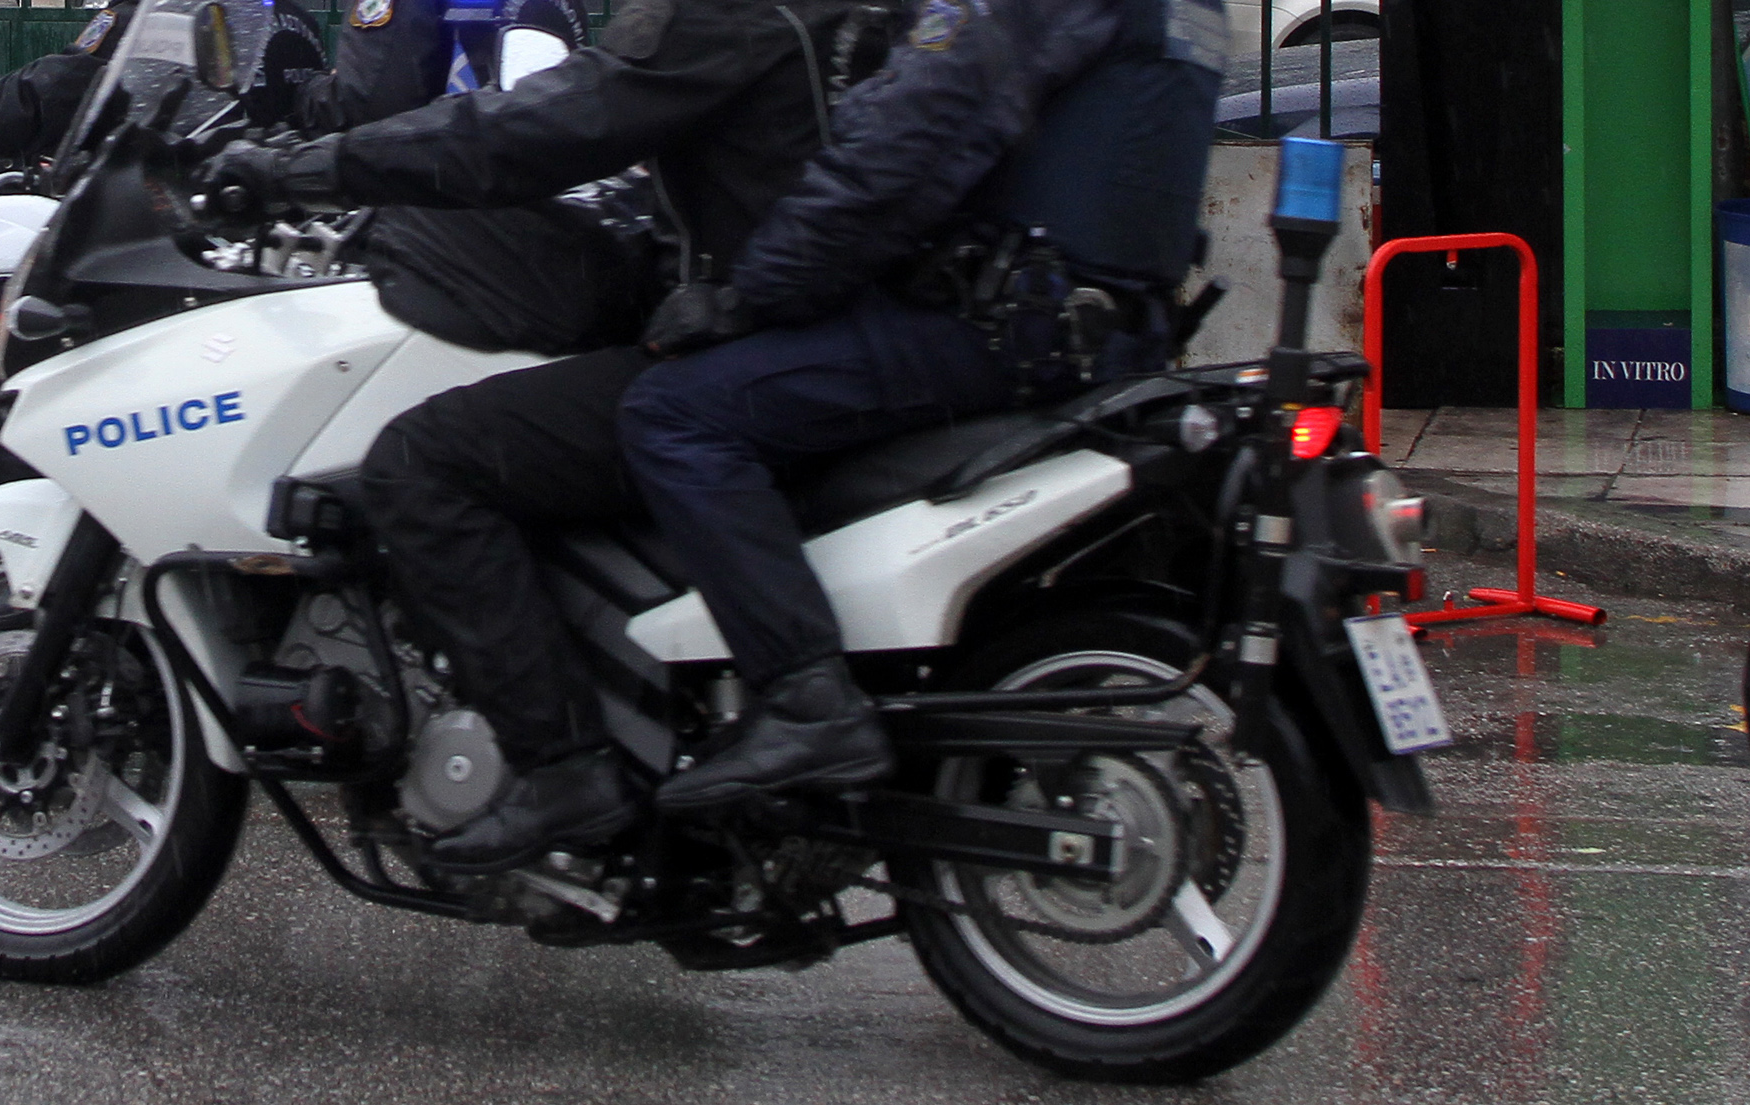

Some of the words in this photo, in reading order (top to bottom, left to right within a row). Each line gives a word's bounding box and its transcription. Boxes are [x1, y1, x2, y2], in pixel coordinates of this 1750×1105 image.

[1593, 360, 1616, 380] IN
[1620, 360, 1685, 382] VITRO
[64, 390, 246, 456] POLICE
